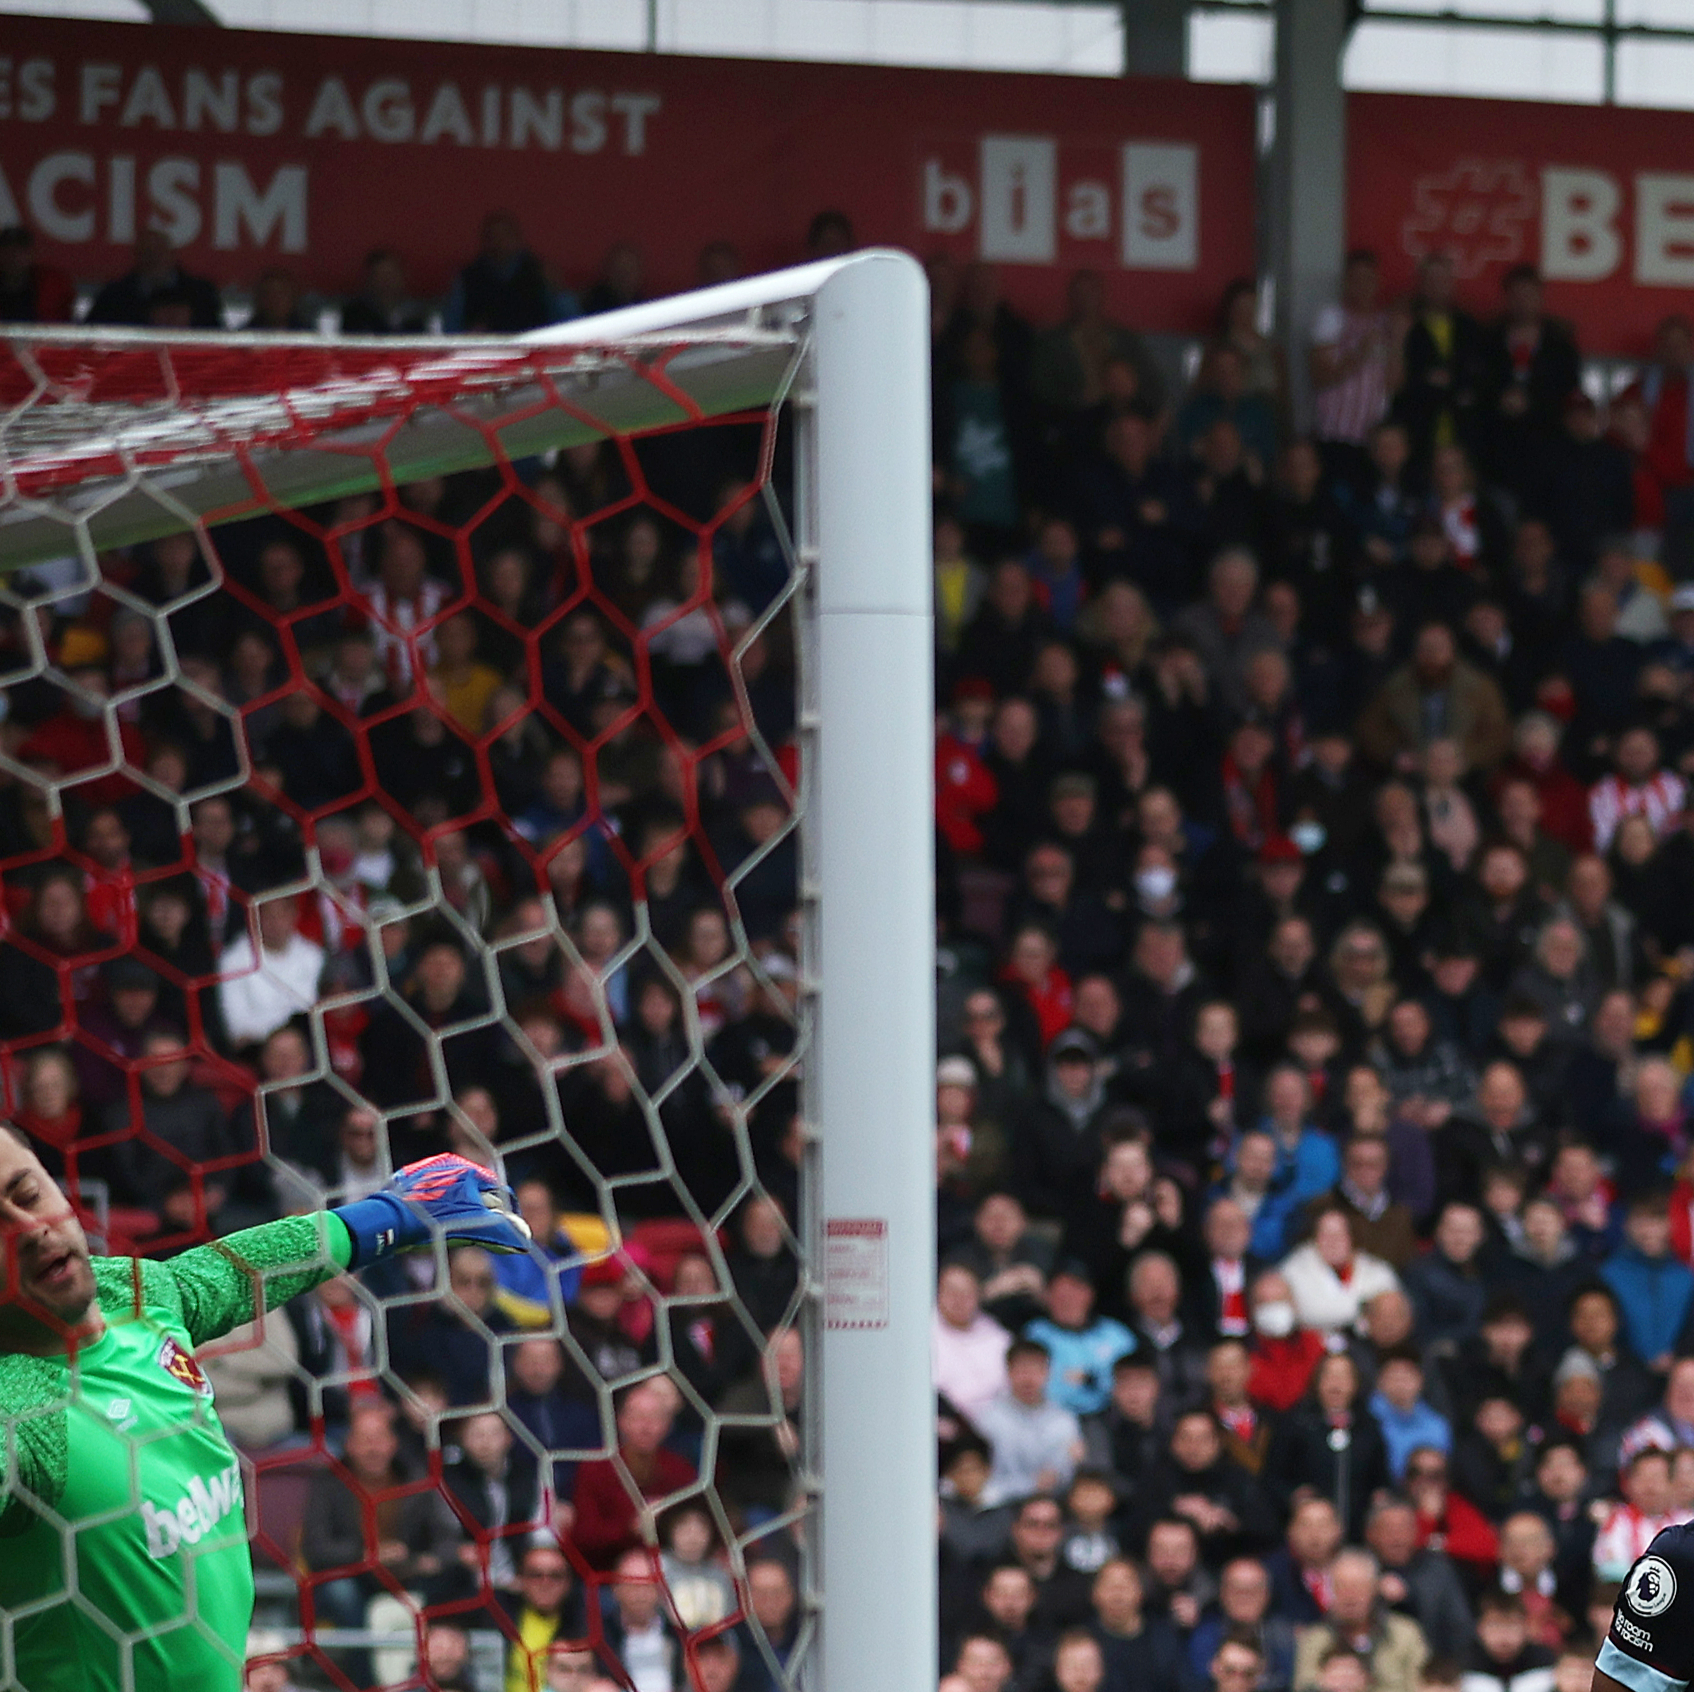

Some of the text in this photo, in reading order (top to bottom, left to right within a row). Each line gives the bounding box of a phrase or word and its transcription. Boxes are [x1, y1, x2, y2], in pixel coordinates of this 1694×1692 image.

[80, 62, 284, 138] FANS
[304, 72, 662, 158] AGAINST
[0, 150, 309, 256] CISM
[922, 152, 1188, 246] bias
[1621, 1628, 1654, 1653] racism
[1624, 1618, 1651, 1641] room
